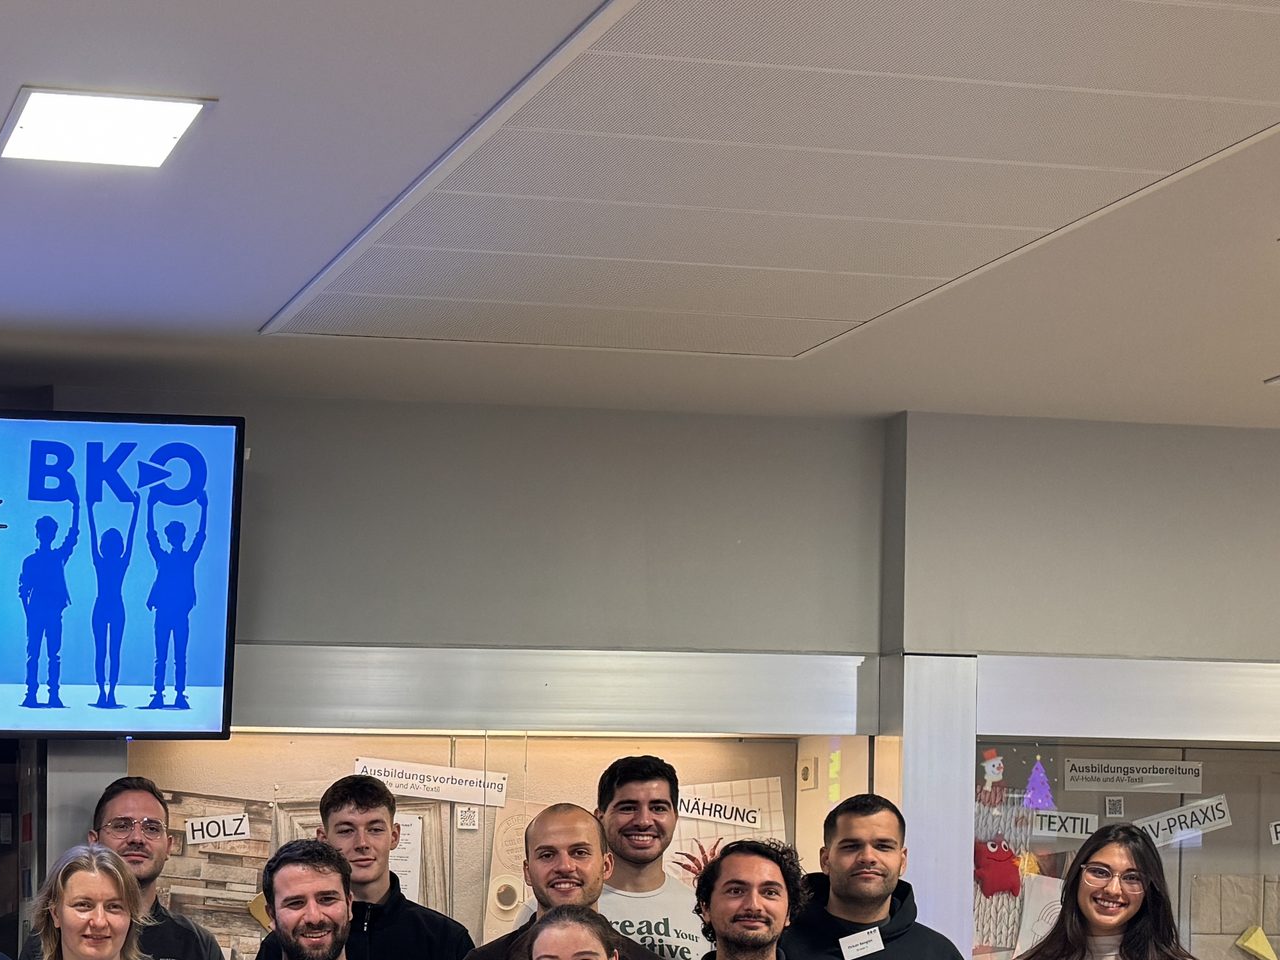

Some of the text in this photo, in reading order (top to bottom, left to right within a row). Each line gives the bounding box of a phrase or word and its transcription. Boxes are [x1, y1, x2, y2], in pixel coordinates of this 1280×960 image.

[360, 765, 504, 793] Ausbildungsvorbereitung
[1069, 763, 1200, 777] Ausbildungsvorbereitung
[679, 797, 757, 824] NÄHRUNG
[191, 818, 246, 840] HOLZ
[1036, 813, 1094, 835] TEXTIL
[674, 929, 700, 943] Your
